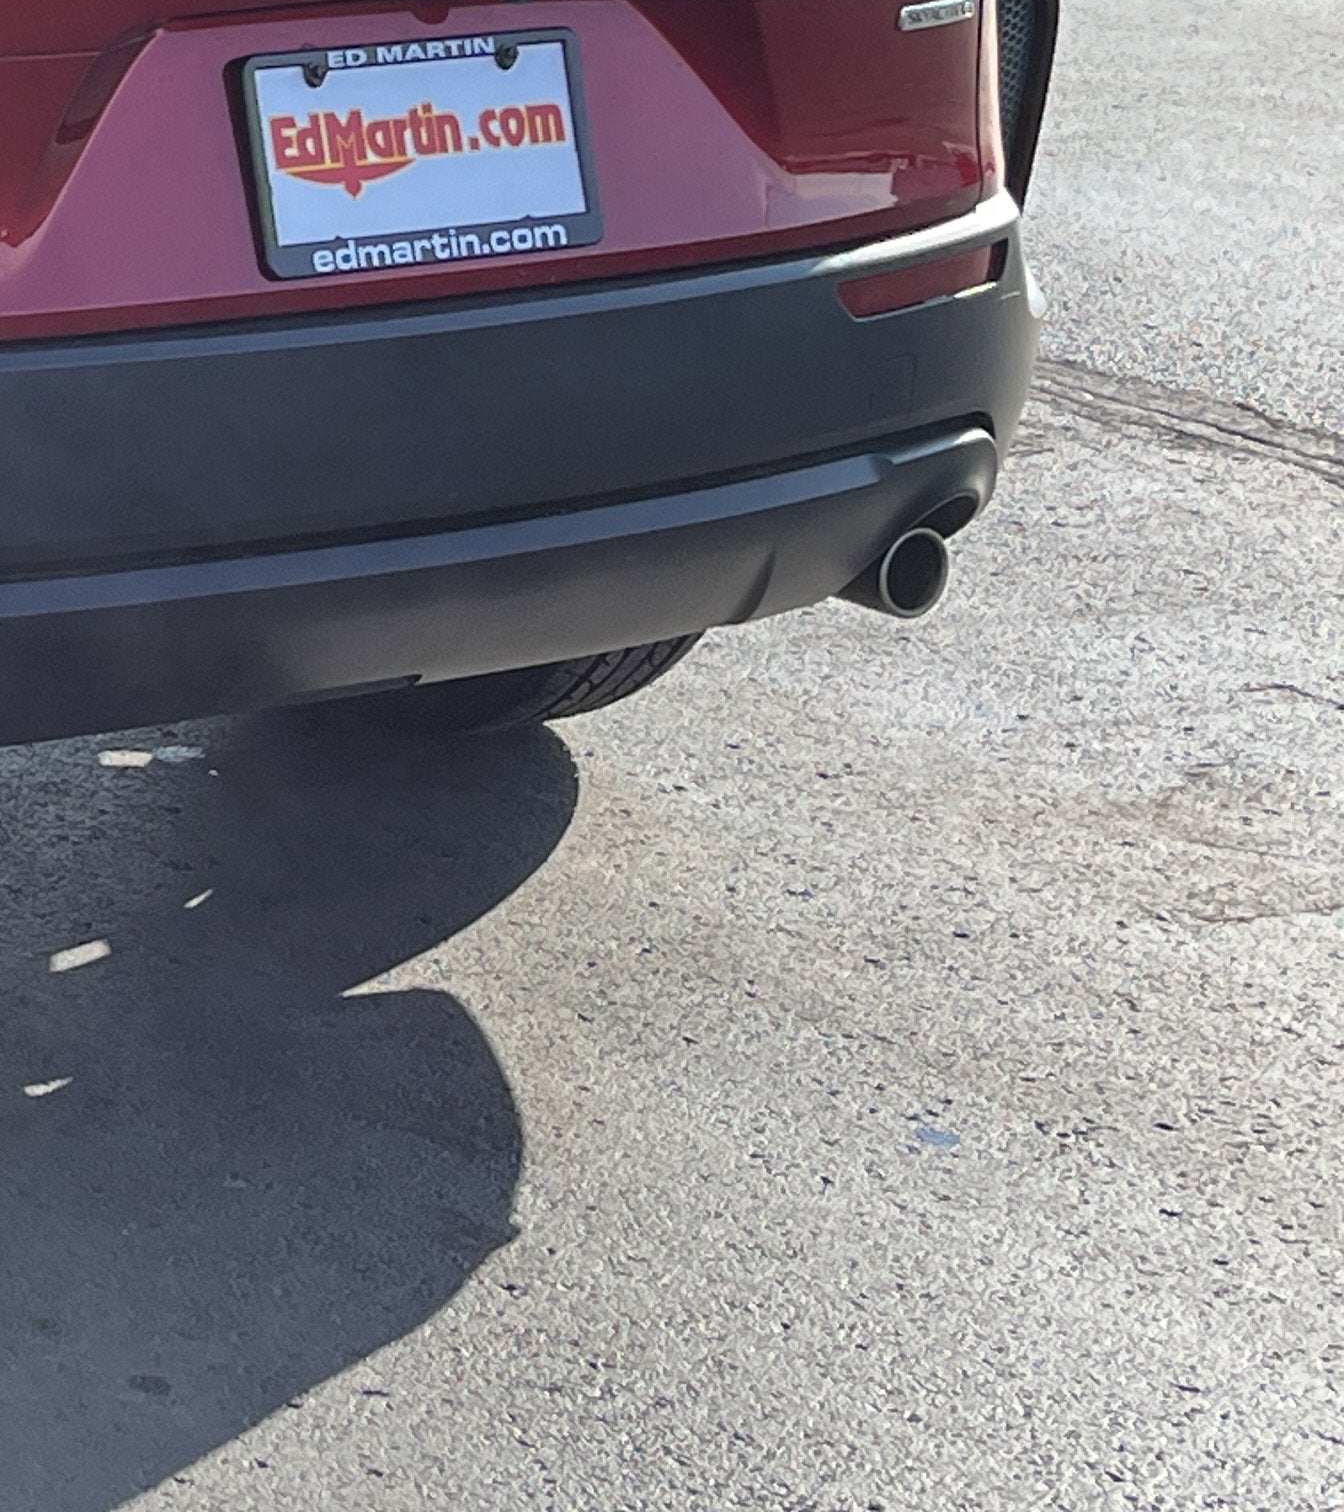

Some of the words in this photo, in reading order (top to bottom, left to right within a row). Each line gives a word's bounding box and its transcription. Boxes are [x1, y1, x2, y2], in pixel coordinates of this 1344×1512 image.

[327, 47, 371, 69] ED
[377, 36, 495, 65] MARTIN
[269, 101, 567, 169] EdMartin.com
[312, 221, 569, 273] edmartin.com
